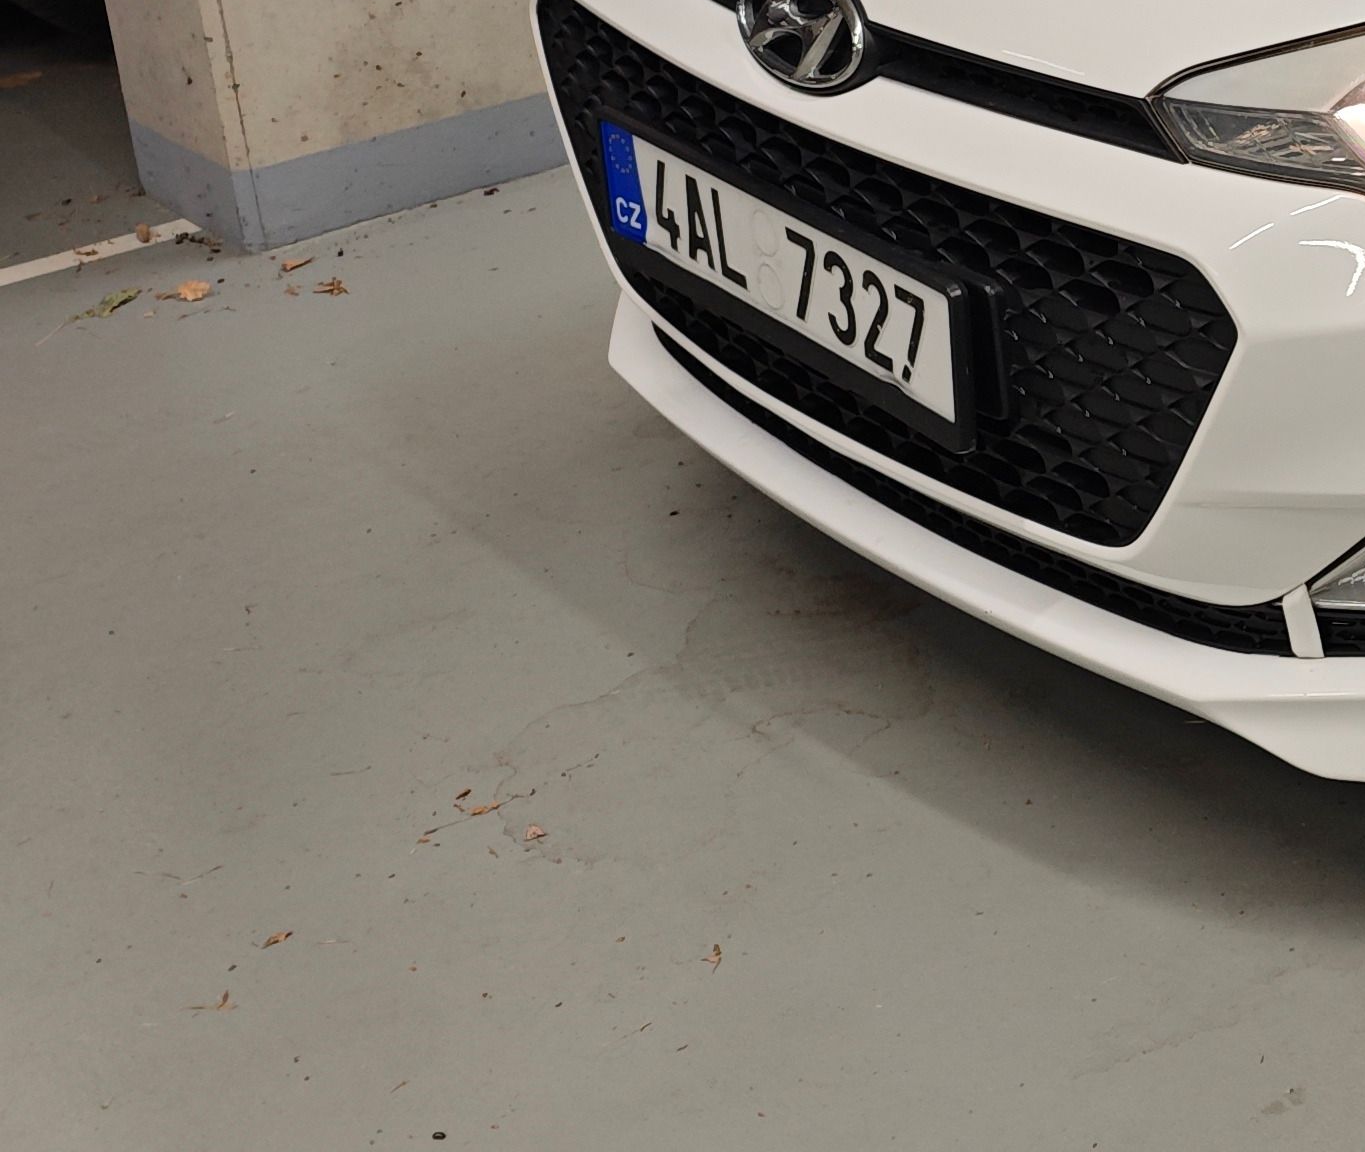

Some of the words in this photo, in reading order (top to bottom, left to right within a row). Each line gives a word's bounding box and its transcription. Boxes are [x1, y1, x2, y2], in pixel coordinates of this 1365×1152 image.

[616, 197, 643, 229] CZ
[656, 160, 748, 290] 4AL
[785, 227, 925, 383] 7327
